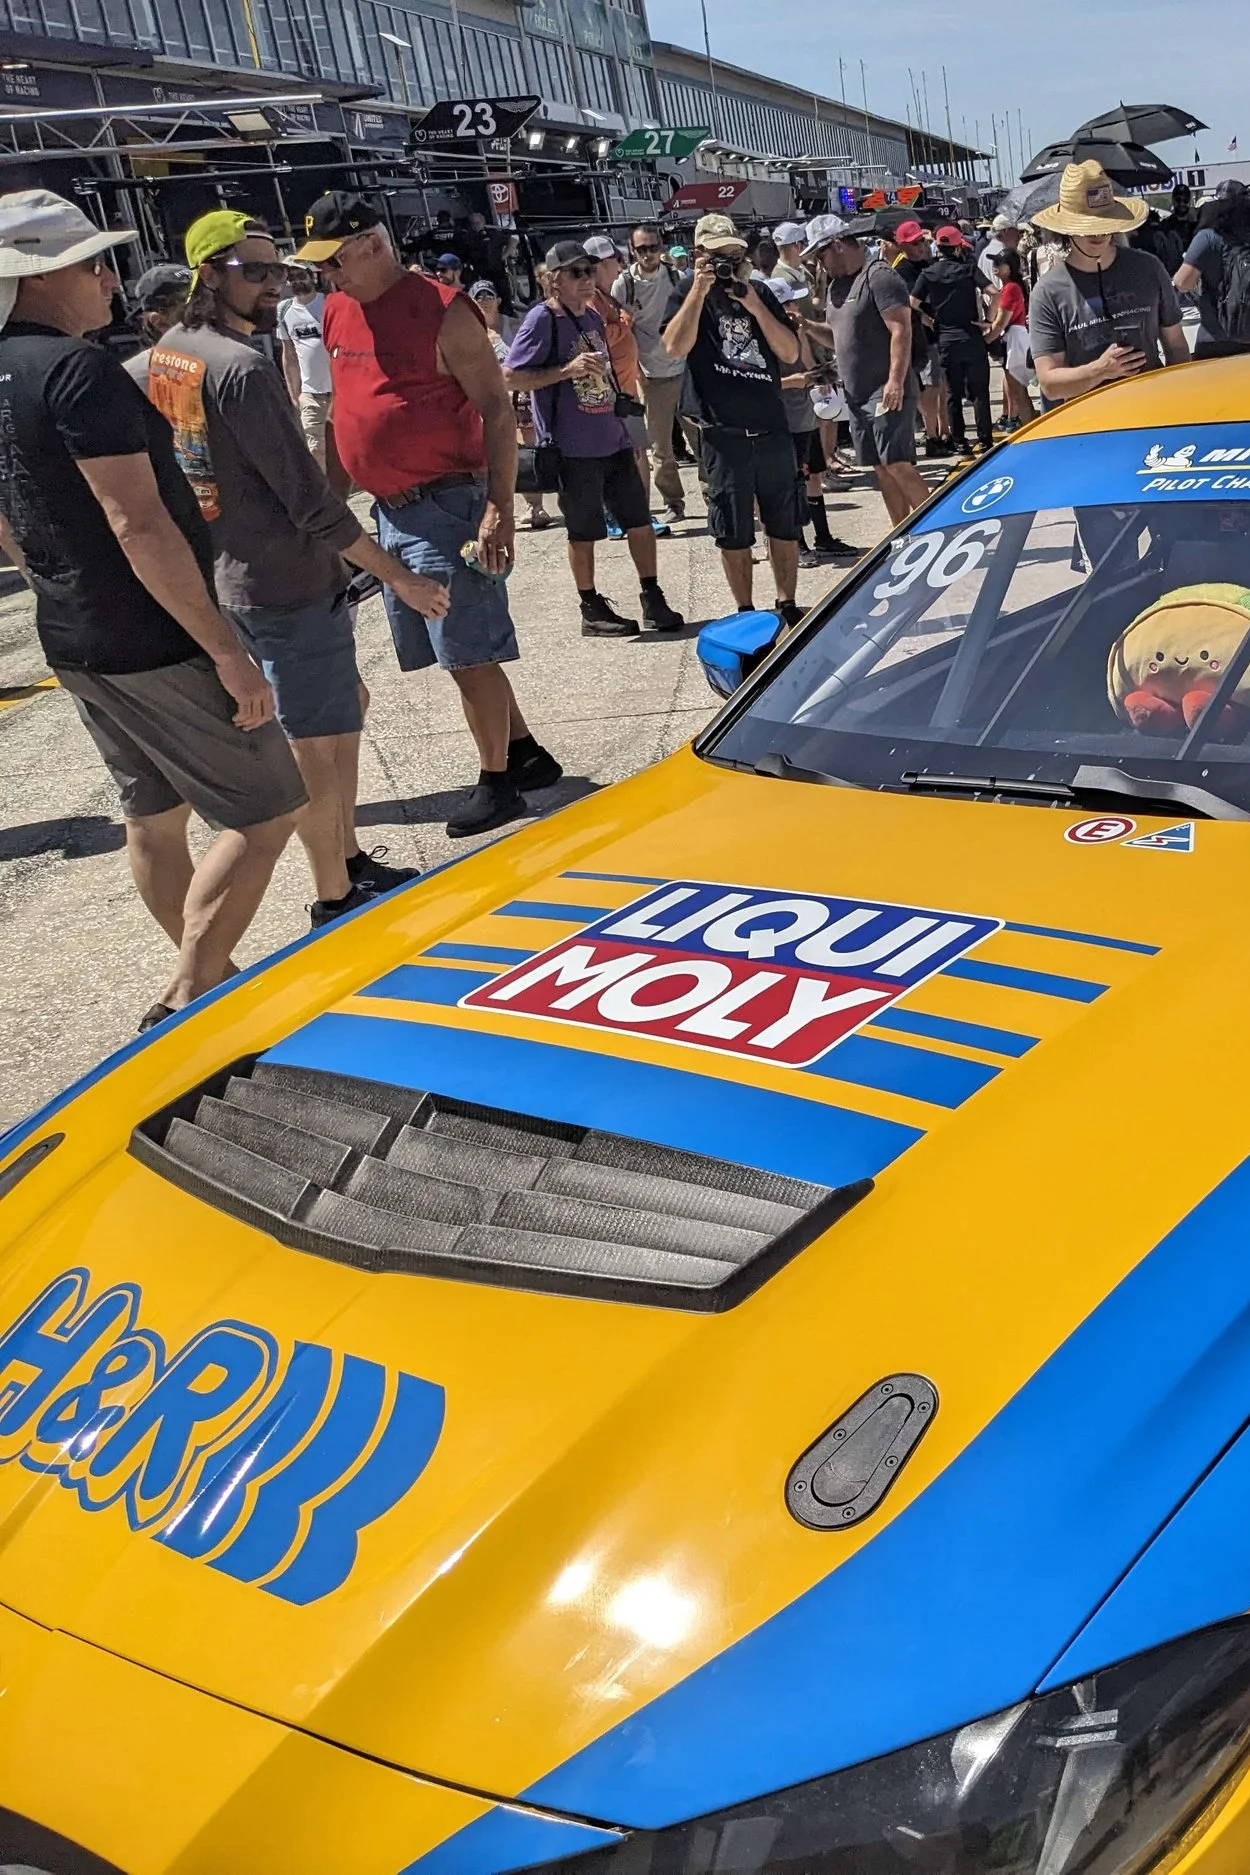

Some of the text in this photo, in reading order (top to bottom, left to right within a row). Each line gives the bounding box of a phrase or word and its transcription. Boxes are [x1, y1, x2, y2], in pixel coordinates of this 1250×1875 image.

[453, 103, 496, 136] 23
[644, 130, 675, 155] 27
[1186, 169, 1205, 188] 1
[718, 186, 735, 198] 22
[1142, 476, 1212, 493] PILOT
[873, 519, 1001, 600] 96
[1081, 822, 1120, 838] E
[601, 886, 958, 979] LIQUI
[488, 945, 892, 1049] MOLY
